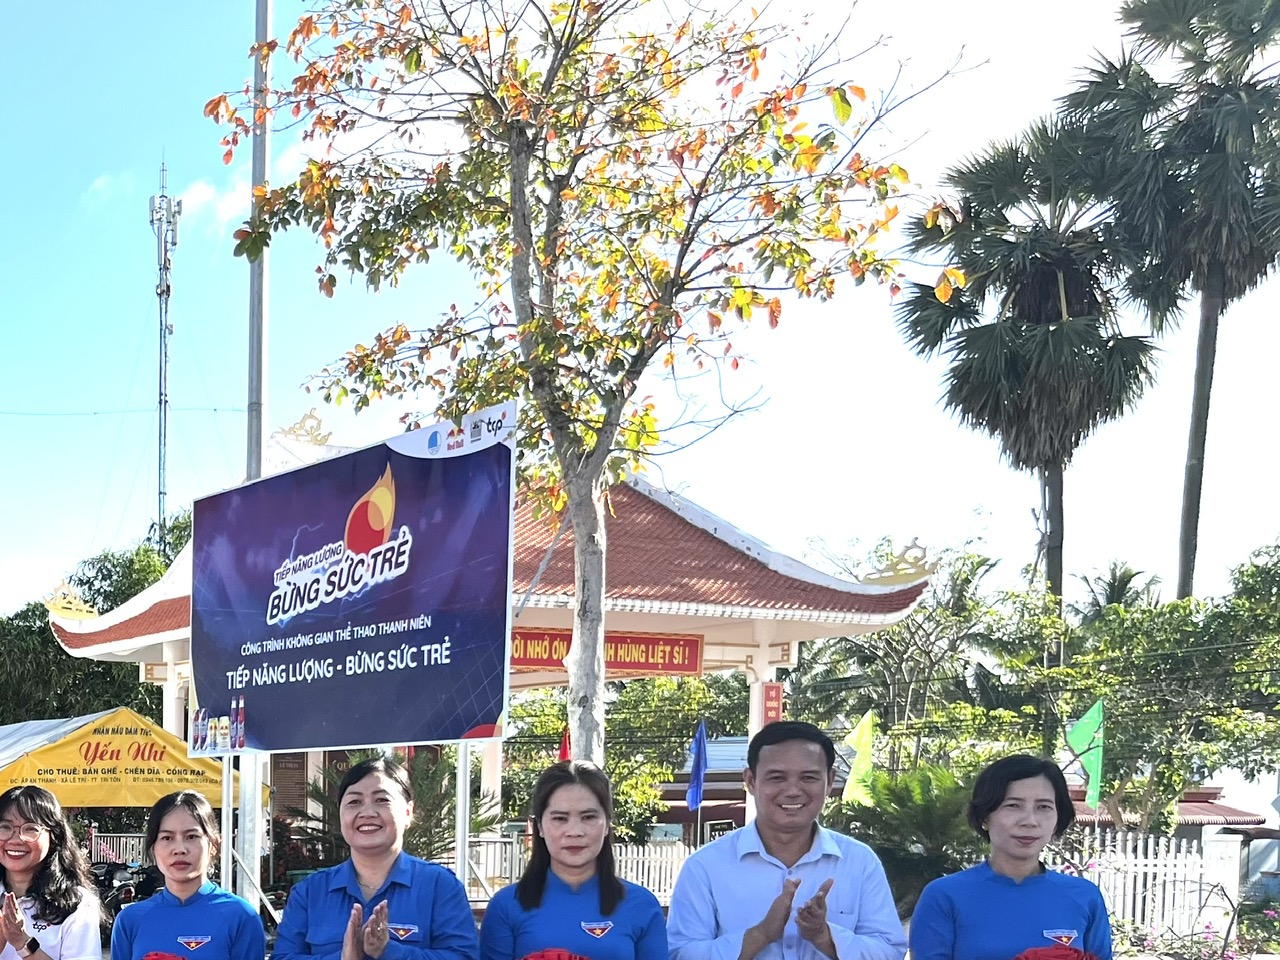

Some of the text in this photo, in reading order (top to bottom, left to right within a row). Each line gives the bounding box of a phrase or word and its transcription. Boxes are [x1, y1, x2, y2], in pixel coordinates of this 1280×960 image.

[486, 417, 503, 437] tcp
[269, 530, 410, 621] BỪNG SỨC TRẺ
[275, 563, 291, 583] TIẾP
[291, 558, 313, 576] NĂNG
[241, 613, 432, 656] CÔNG TRÌNH KHÔNG GIAN THỂ THAO THANH NIÊN
[226, 664, 251, 690] TIẾP
[252, 662, 287, 687] NĂNG
[289, 658, 334, 684] LƯỢNG
[345, 650, 385, 676] BỪNG
[387, 643, 418, 671] SỨC
[420, 635, 452, 667] TRẺ
[510, 633, 524, 659] ỜI
[527, 635, 550, 660] NHỚ
[552, 640, 568, 661] ƠN
[617, 638, 646, 664] HÙNG
[648, 641, 671, 669] LIỆT
[78, 741, 167, 766] Yến Nhi
[37, 768, 54, 776] CHO
[56, 766, 80, 776] THUÊ:
[101, 766, 118, 775] GHẾ
